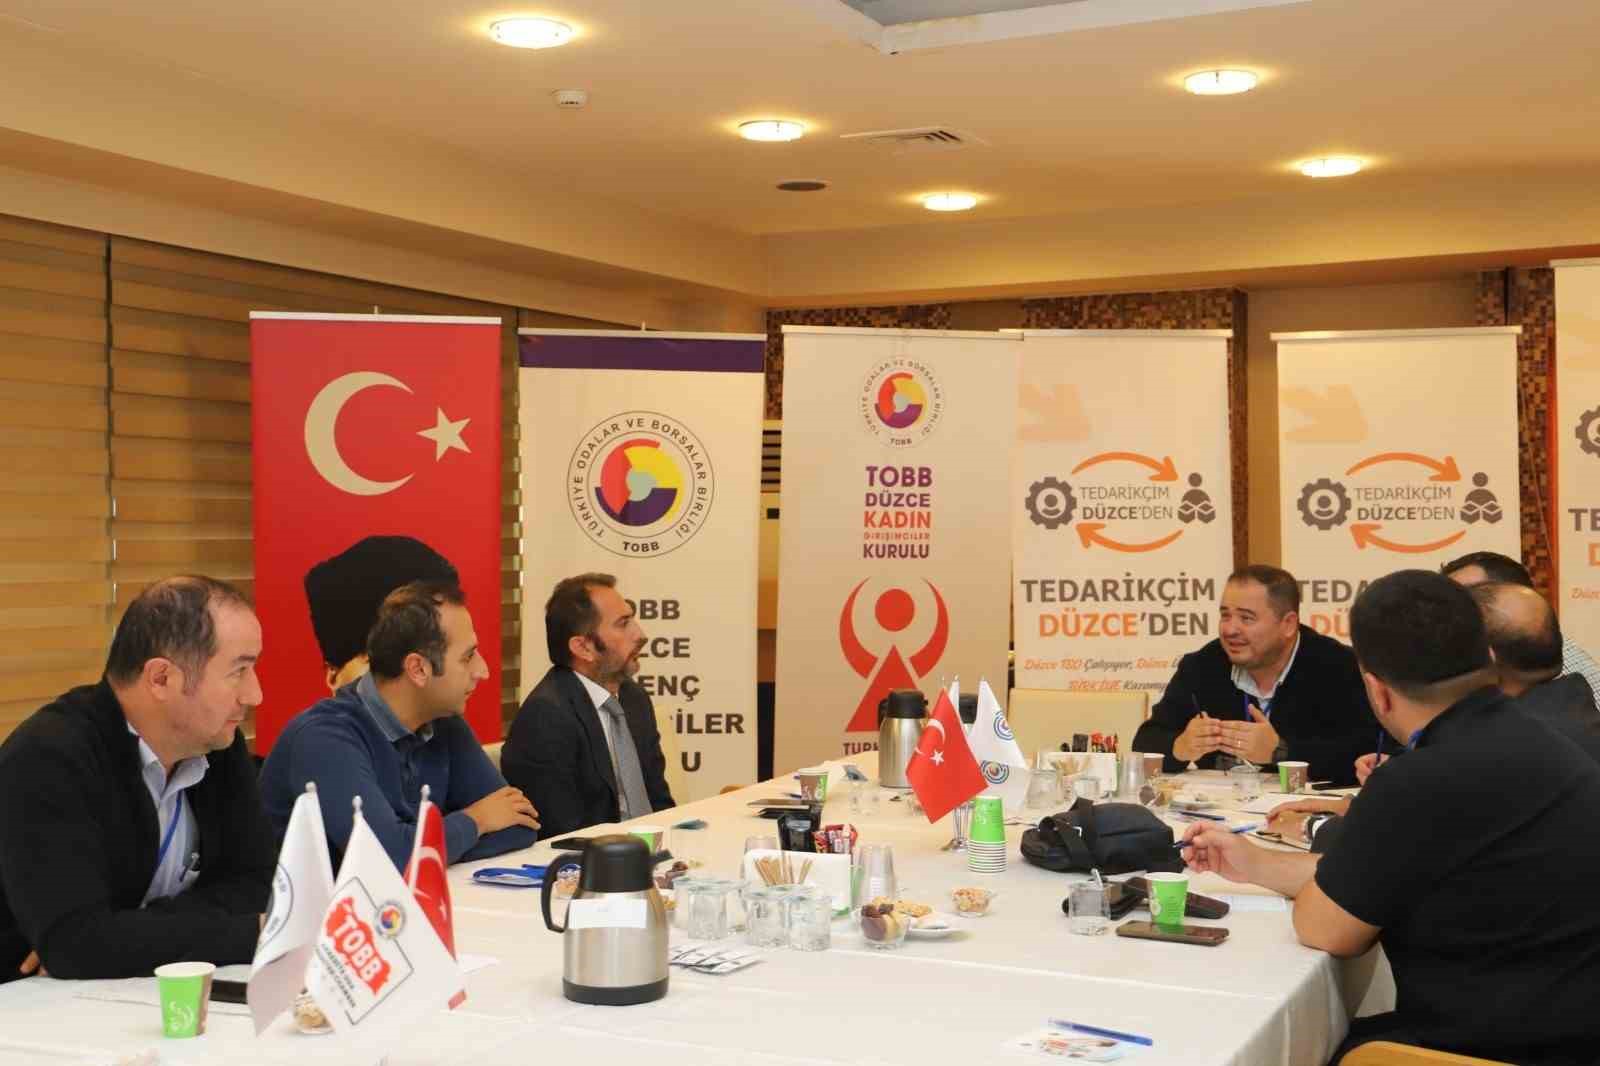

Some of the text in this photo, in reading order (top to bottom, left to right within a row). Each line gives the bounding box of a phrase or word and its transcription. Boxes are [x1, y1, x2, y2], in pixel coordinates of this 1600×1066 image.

[576, 422, 621, 470] ODALAR
[626, 418, 645, 429] VE
[651, 419, 708, 480] BORSALAR
[866, 466, 932, 487] TOBB
[865, 489, 931, 508] DÜZCE
[1080, 484, 1169, 502] TEDARİKÇİM
[1354, 483, 1452, 503] TEDARİKÇİM
[864, 511, 931, 529] KADIN
[622, 541, 660, 553] TOBB
[864, 544, 930, 559] KURULU
[1020, 572, 1215, 607] TEDARİKÇİM
[670, 709, 745, 734] İLER
[681, 751, 701, 772] U
[333, 914, 383, 983] TOBB
